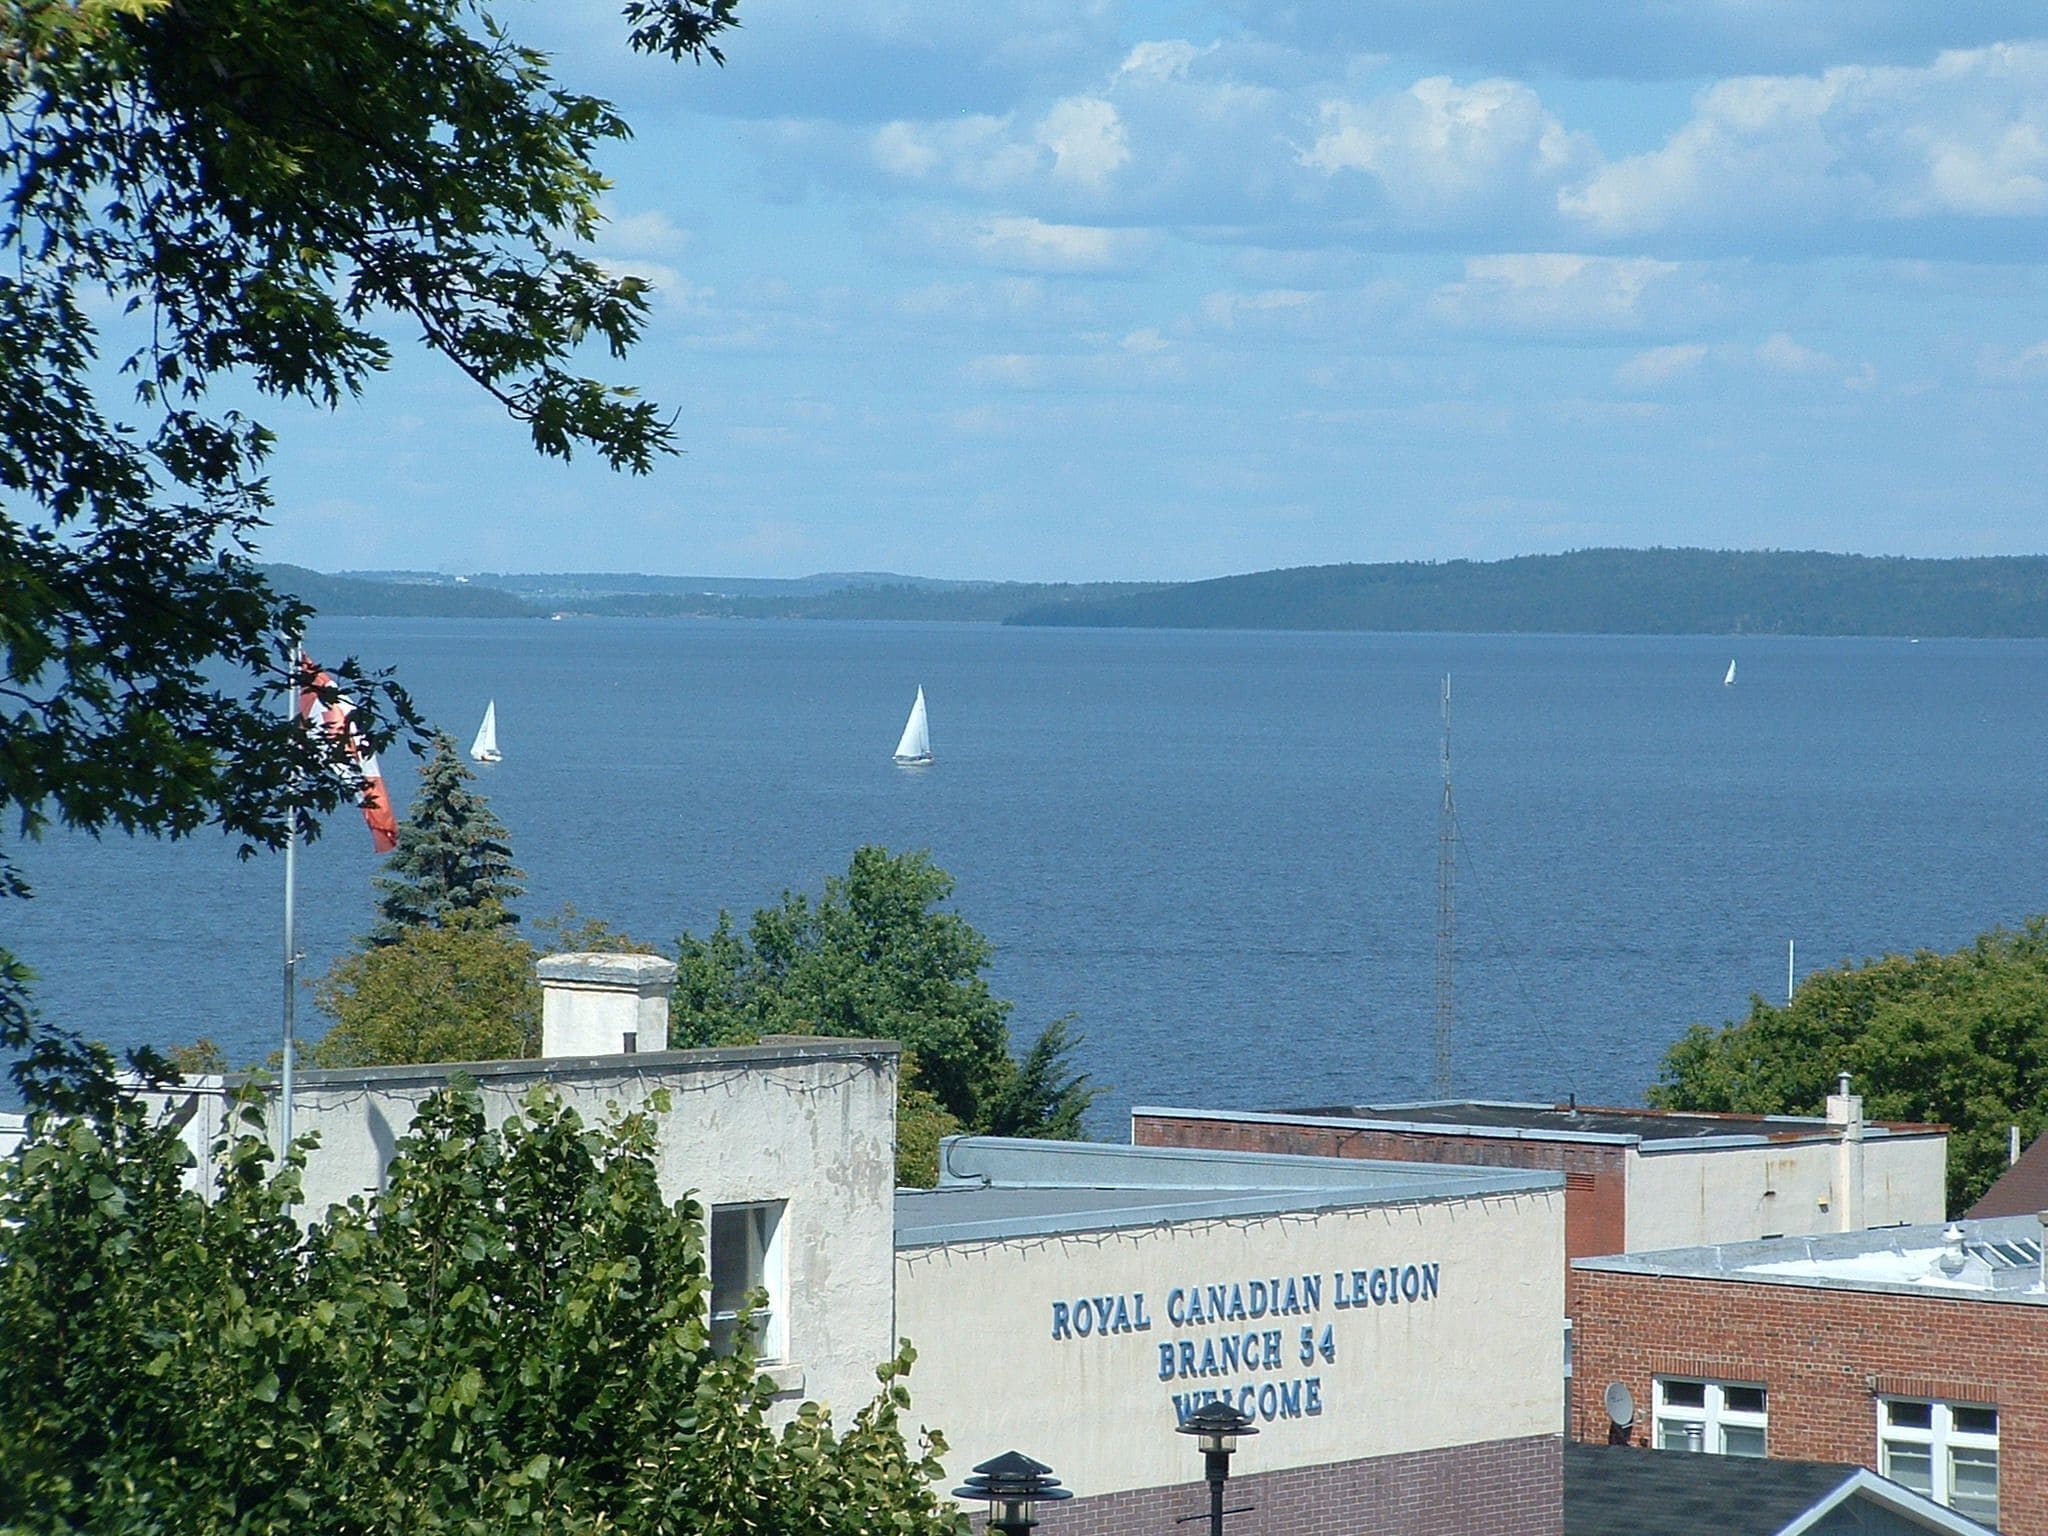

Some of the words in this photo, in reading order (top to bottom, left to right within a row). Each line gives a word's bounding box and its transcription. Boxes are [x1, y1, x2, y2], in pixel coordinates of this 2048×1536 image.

[1052, 1293, 1151, 1340] ROYAL
[1167, 1274, 1322, 1327] CANADIAN
[1334, 1262, 1440, 1310] LEGION
[1158, 1329, 1282, 1381] BRANCH
[1300, 1324, 1336, 1367] 54
